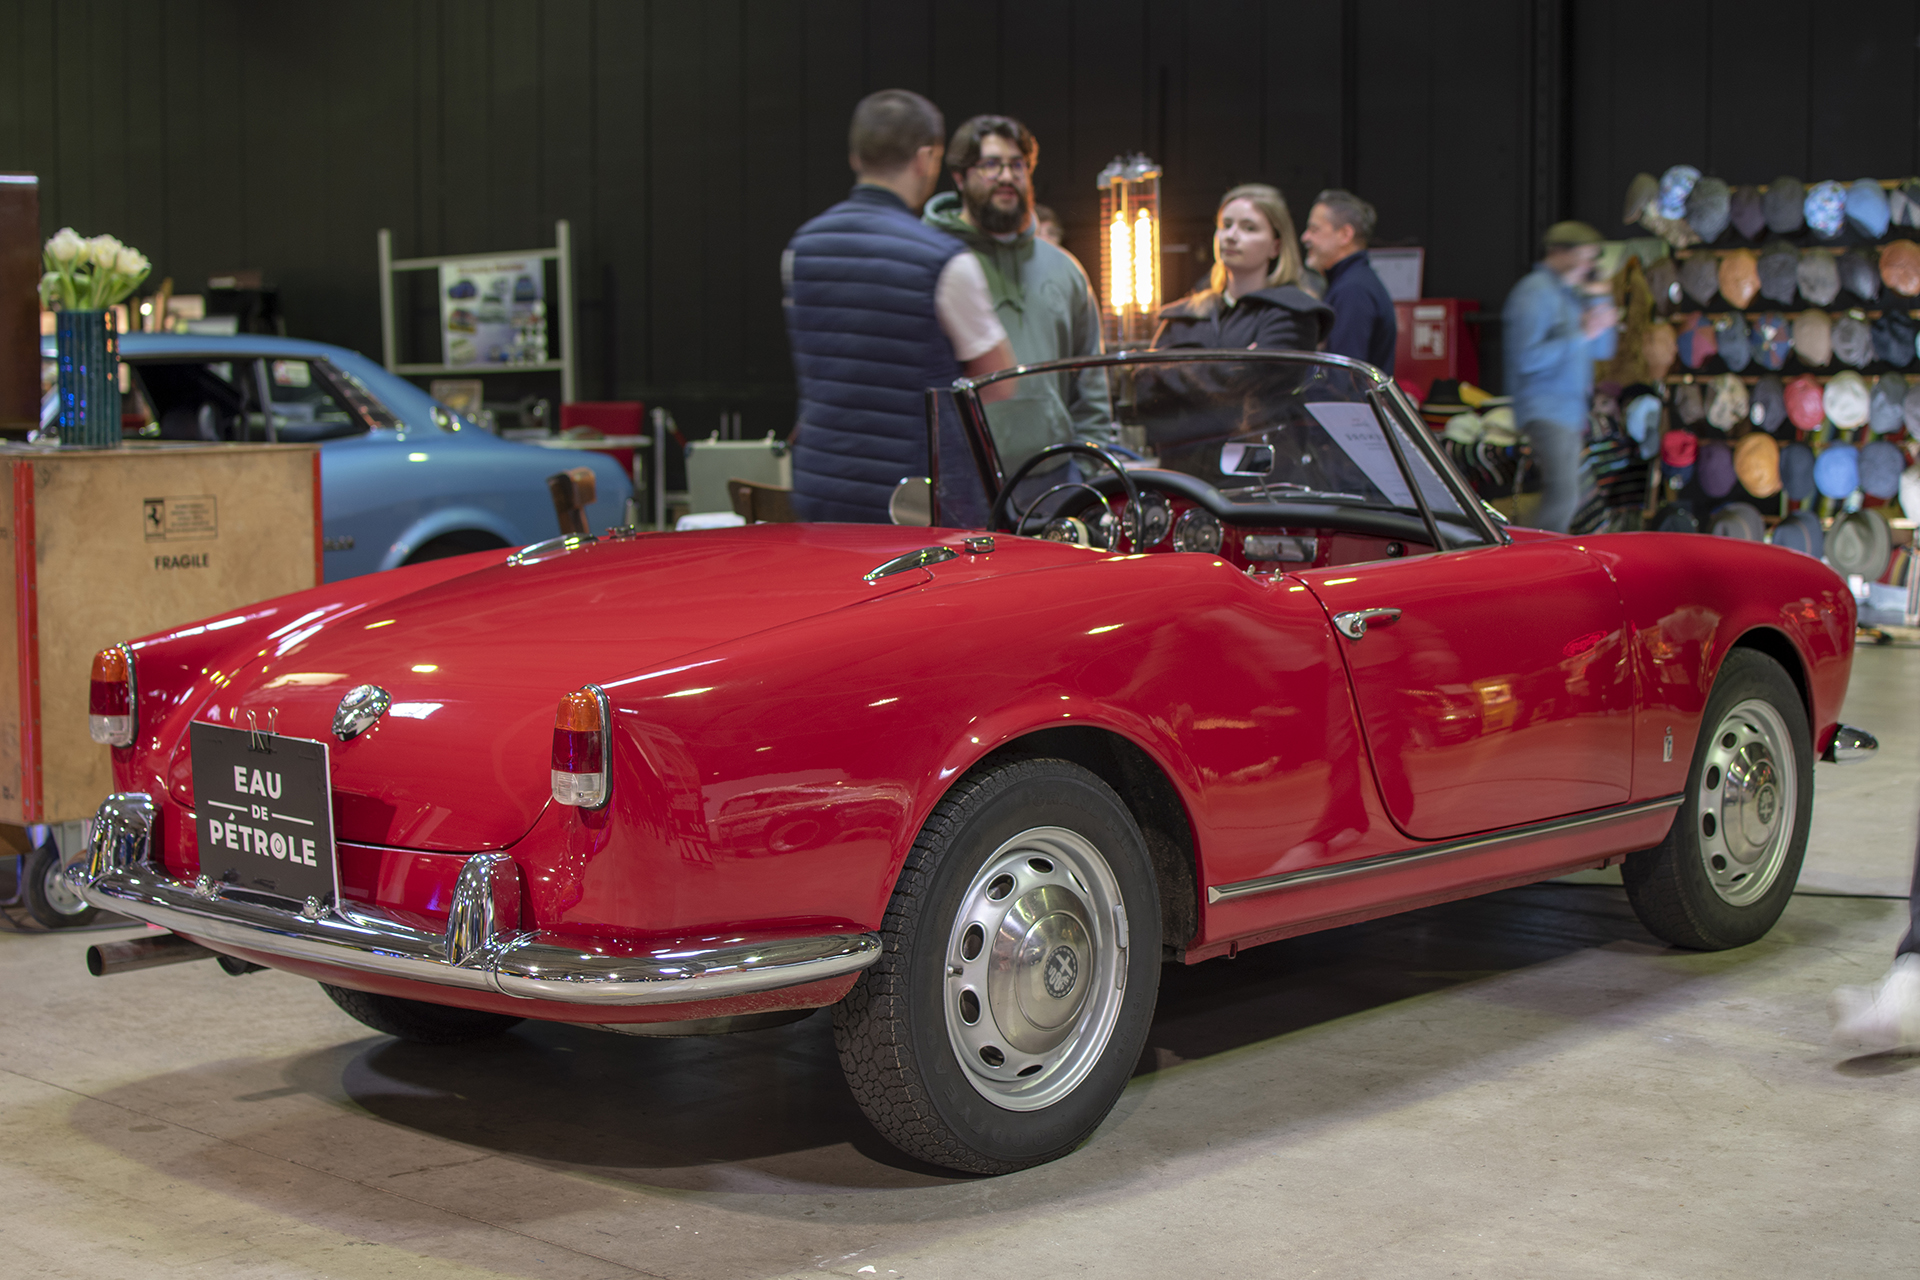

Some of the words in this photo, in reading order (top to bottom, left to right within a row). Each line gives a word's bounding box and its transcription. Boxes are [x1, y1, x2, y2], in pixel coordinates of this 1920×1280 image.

[155, 553, 210, 570] FRAGILE
[234, 765, 282, 799] EAU
[251, 804, 269, 821] DE
[209, 812, 317, 867] PÉTROLE
